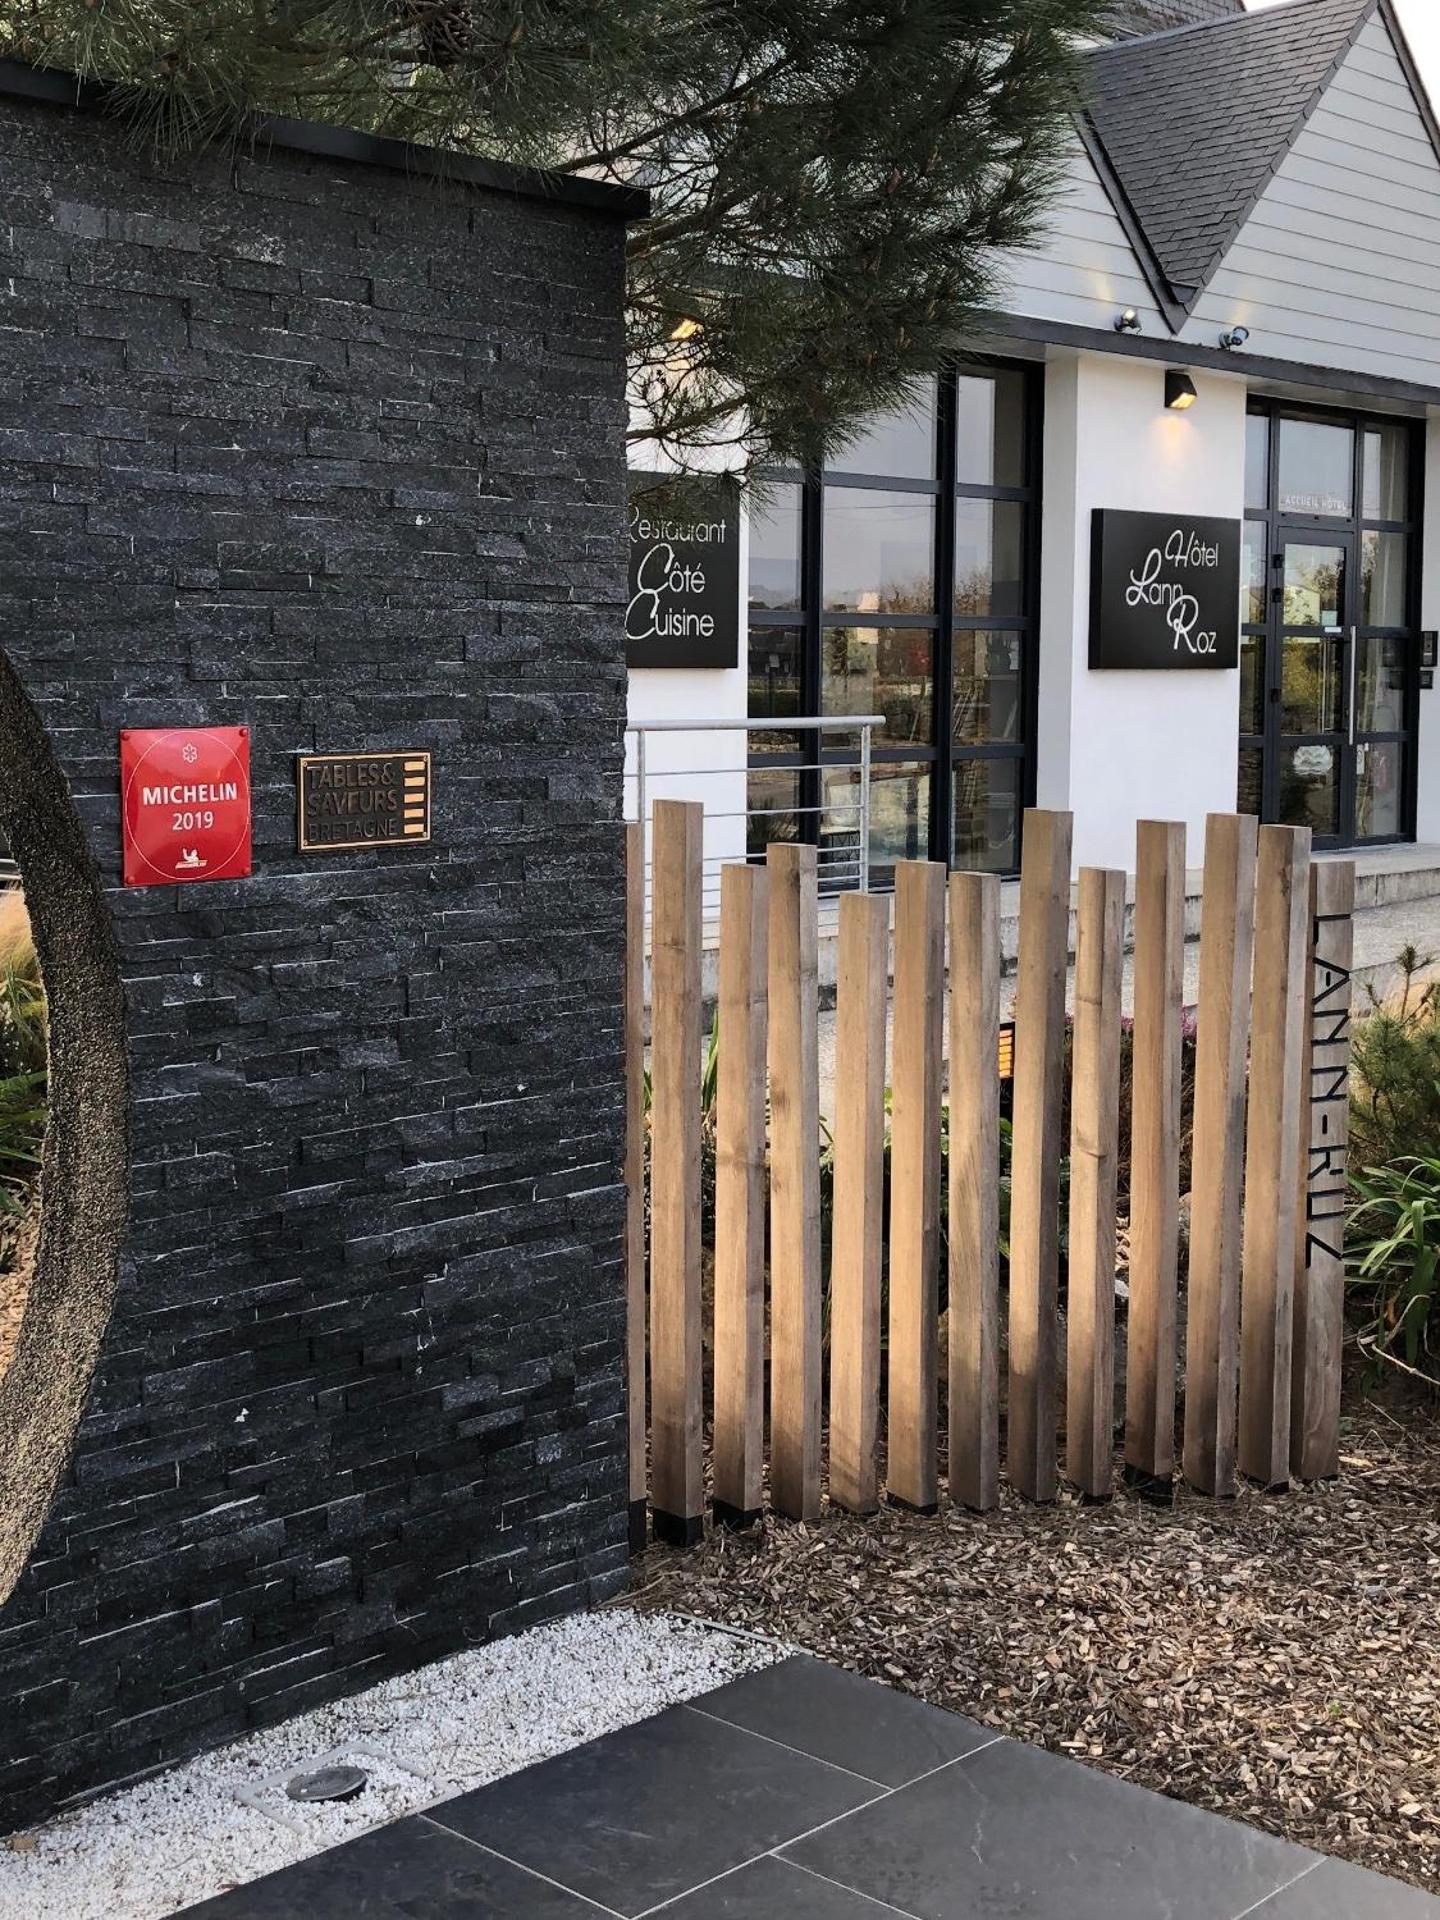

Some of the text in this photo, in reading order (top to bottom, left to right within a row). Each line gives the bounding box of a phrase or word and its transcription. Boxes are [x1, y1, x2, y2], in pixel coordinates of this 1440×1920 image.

[1165, 529, 1218, 568] Hôtel
[637, 543, 705, 594] Côté
[1126, 548, 1183, 606] Lann
[625, 588, 714, 640] Cuisine
[1166, 594, 1216, 654] Roz
[143, 782, 237, 805] MICHELIN
[307, 789, 398, 816] SAVEURS
[172, 811, 214, 831] 2019
[309, 818, 398, 841] BRETAGNE
